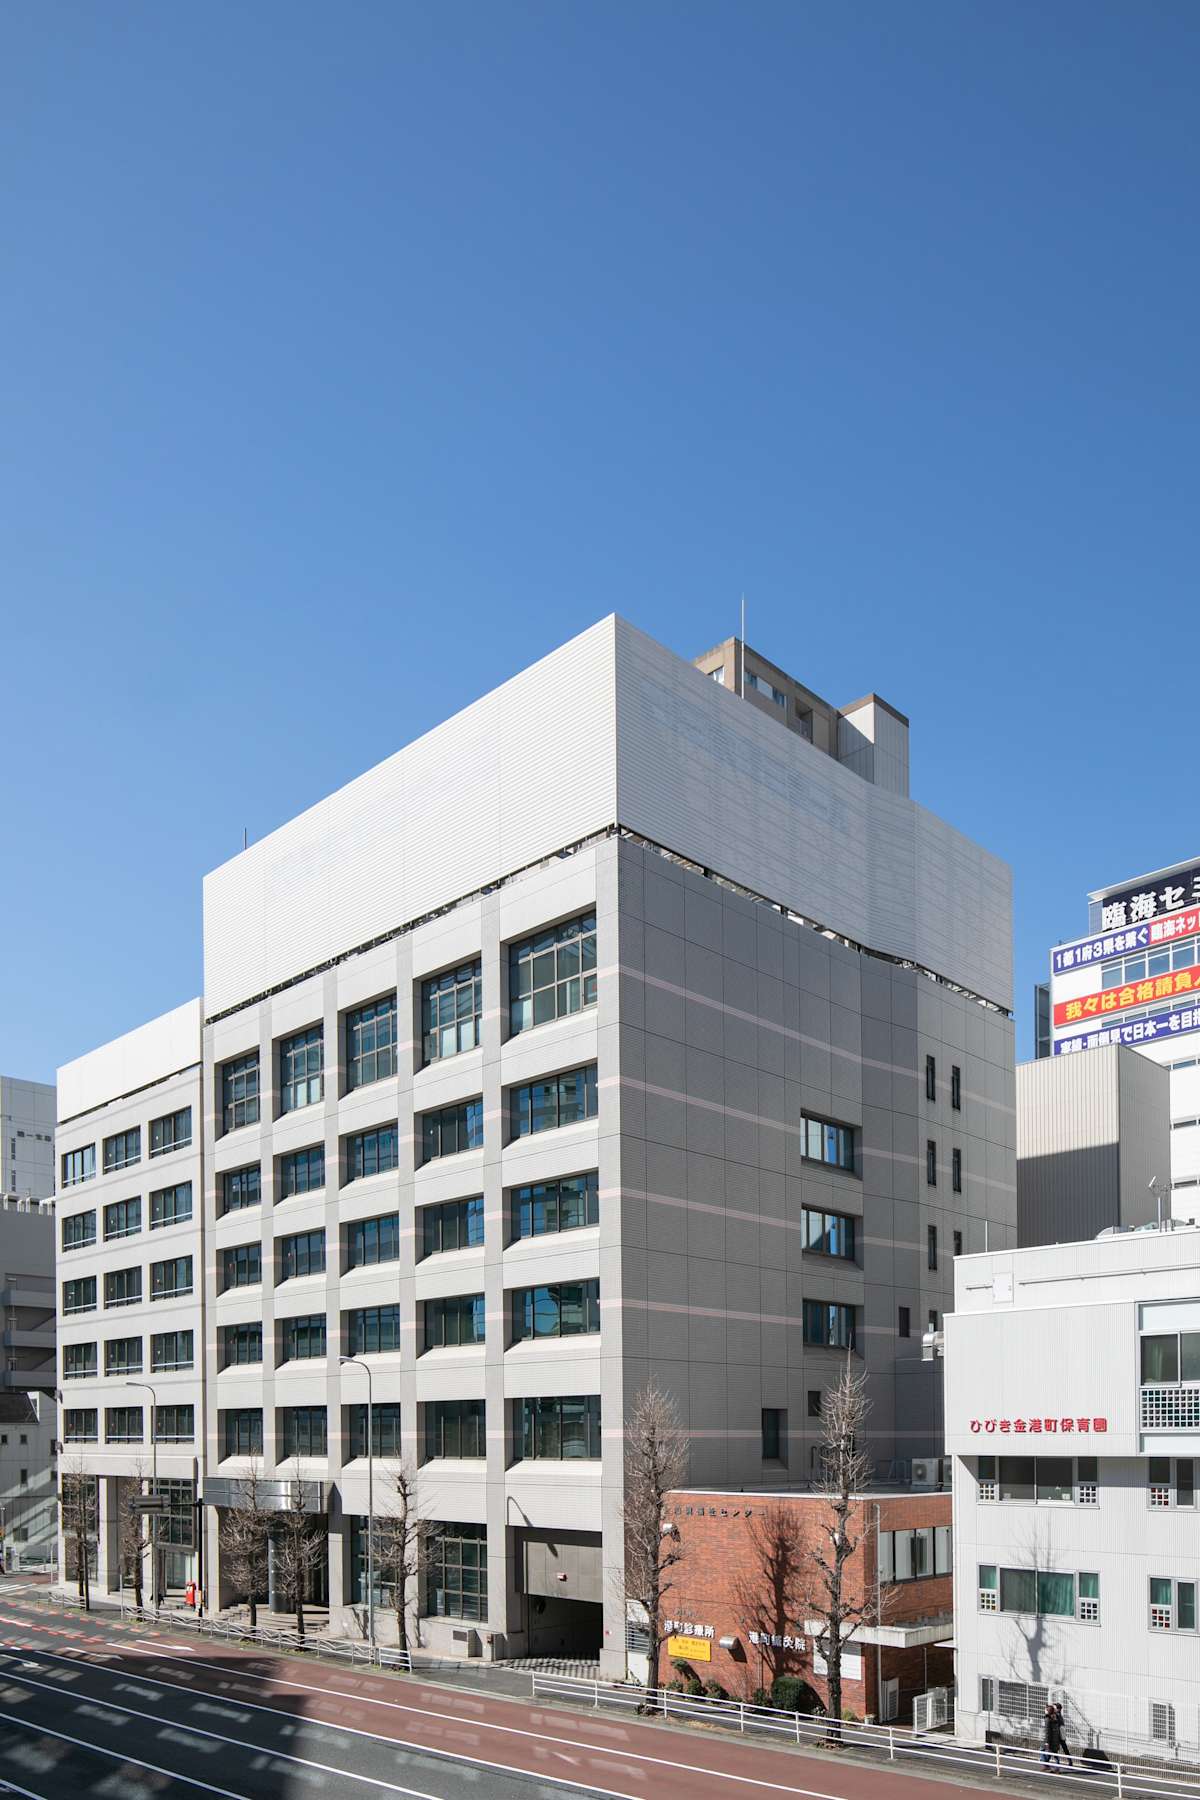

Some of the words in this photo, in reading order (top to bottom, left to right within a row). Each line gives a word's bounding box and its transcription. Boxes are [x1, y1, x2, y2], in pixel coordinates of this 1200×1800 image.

[1150, 911, 1200, 942] 臨海ネッ
[970, 1418, 1107, 1433] ひびき金港町保育園
[664, 1620, 714, 1638] 港町診療所
